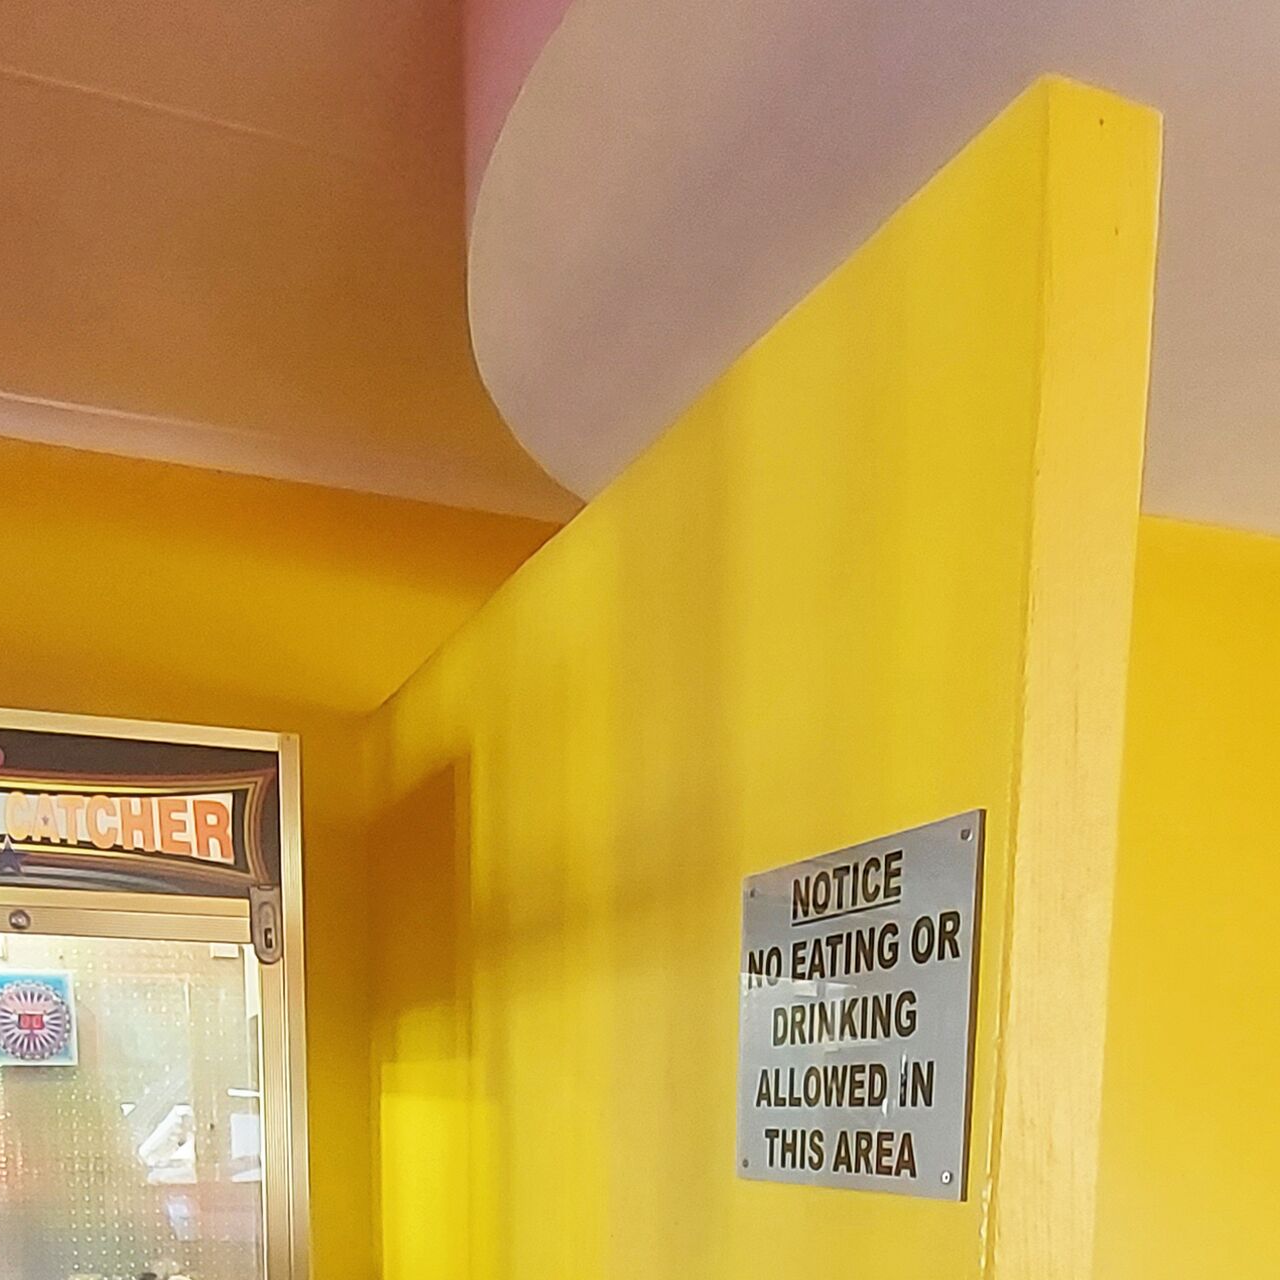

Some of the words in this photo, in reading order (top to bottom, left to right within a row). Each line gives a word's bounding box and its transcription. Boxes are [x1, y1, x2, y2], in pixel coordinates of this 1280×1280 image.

[4, 791, 232, 861] CATCHER
[792, 850, 903, 921] NOTICE
[748, 946, 782, 990] NO
[791, 922, 899, 981] EATING
[911, 910, 961, 964] OR
[772, 990, 917, 1047] DRINKING
[755, 1062, 888, 1108] ALLOWED
[898, 1060, 934, 1108] IN
[765, 1128, 825, 1171] THIS
[832, 1130, 917, 1178] AREA
